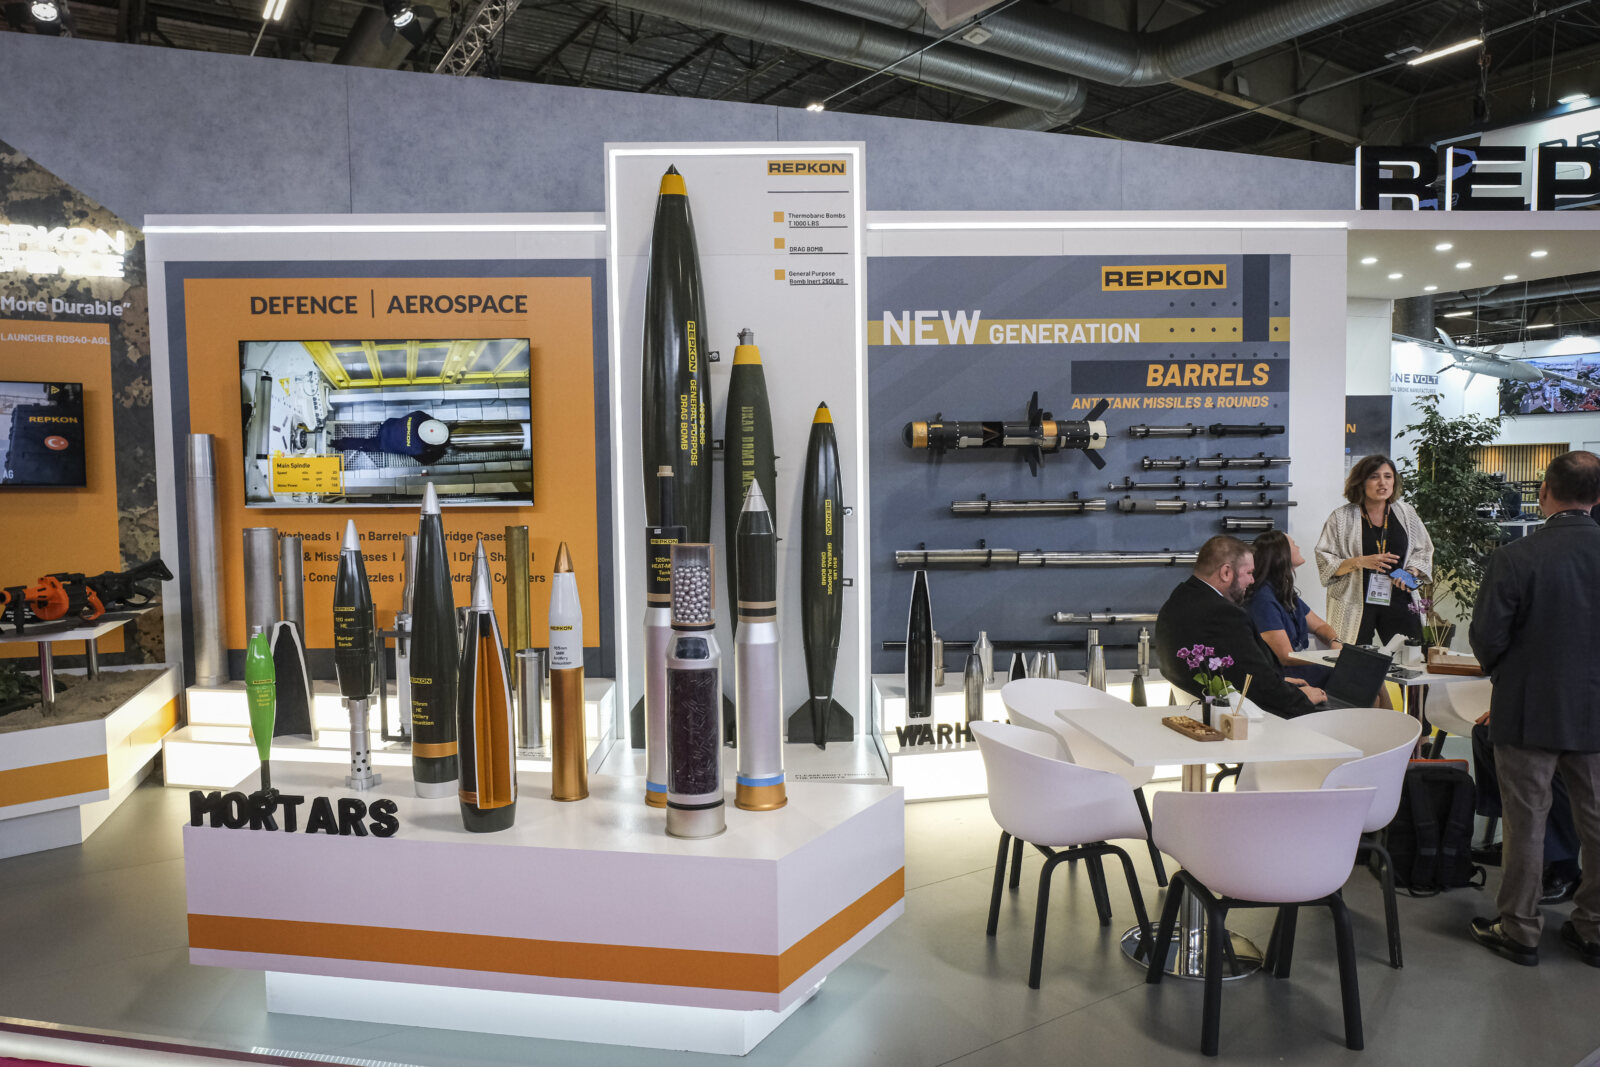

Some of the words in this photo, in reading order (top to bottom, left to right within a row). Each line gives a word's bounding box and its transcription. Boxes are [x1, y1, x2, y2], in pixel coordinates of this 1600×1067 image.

[769, 163, 845, 173] REPKON
[1104, 270, 1224, 286] REPKON
[0, 296, 47, 312] More
[250, 296, 358, 314] DEFENCE
[387, 295, 528, 314] AEROSPACE
[883, 310, 981, 345] NEW
[989, 323, 1140, 344] GENERATION
[0, 333, 53, 343] LAUNCHER
[688, 322, 696, 371] REPKON
[1146, 363, 1270, 387] BARRELS
[1392, 373, 1411, 383] NE
[1414, 375, 1438, 384] VOLT
[1105, 397, 1141, 409] TANK
[1143, 396, 1202, 409] MISSILES
[1204, 396, 1215, 408] &
[1217, 396, 1269, 408] ROUNDS
[476, 531, 507, 541] Cases
[303, 552, 312, 561] &
[361, 553, 388, 561] ases
[189, 790, 399, 838] MORTARS
